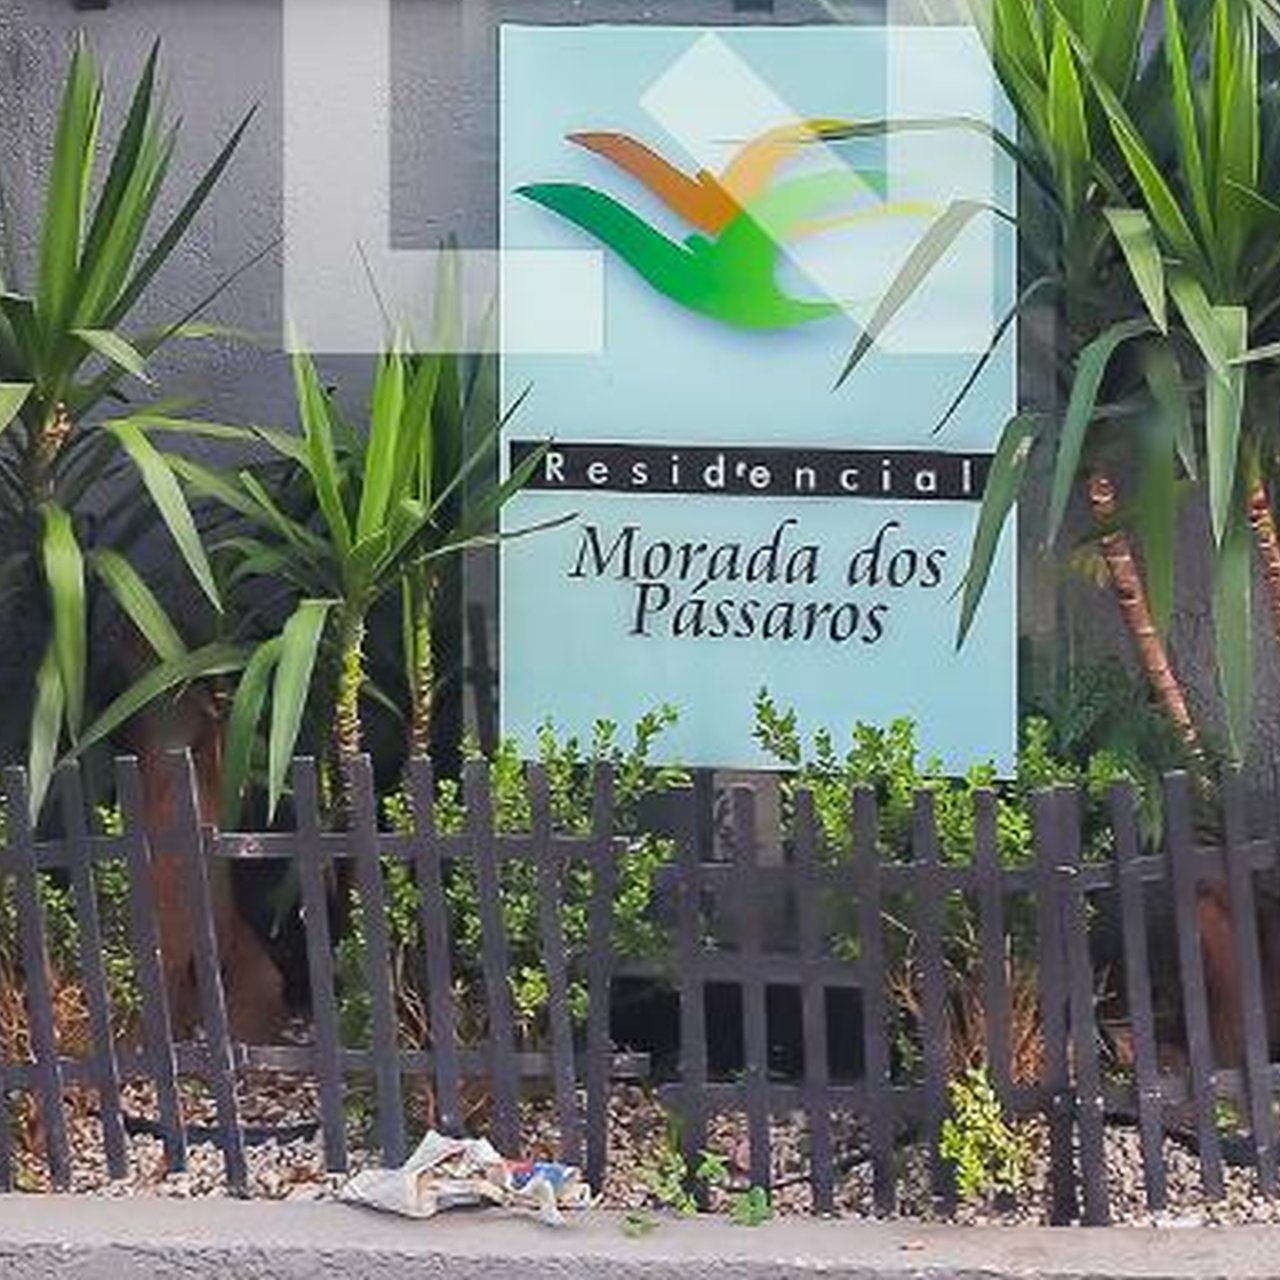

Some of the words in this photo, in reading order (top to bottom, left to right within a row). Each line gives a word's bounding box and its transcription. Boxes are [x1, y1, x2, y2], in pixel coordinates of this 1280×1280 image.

[544, 452, 972, 492] Residencial
[568, 519, 820, 586] Morada
[847, 521, 947, 588] dos
[628, 579, 890, 644] Pássaros
